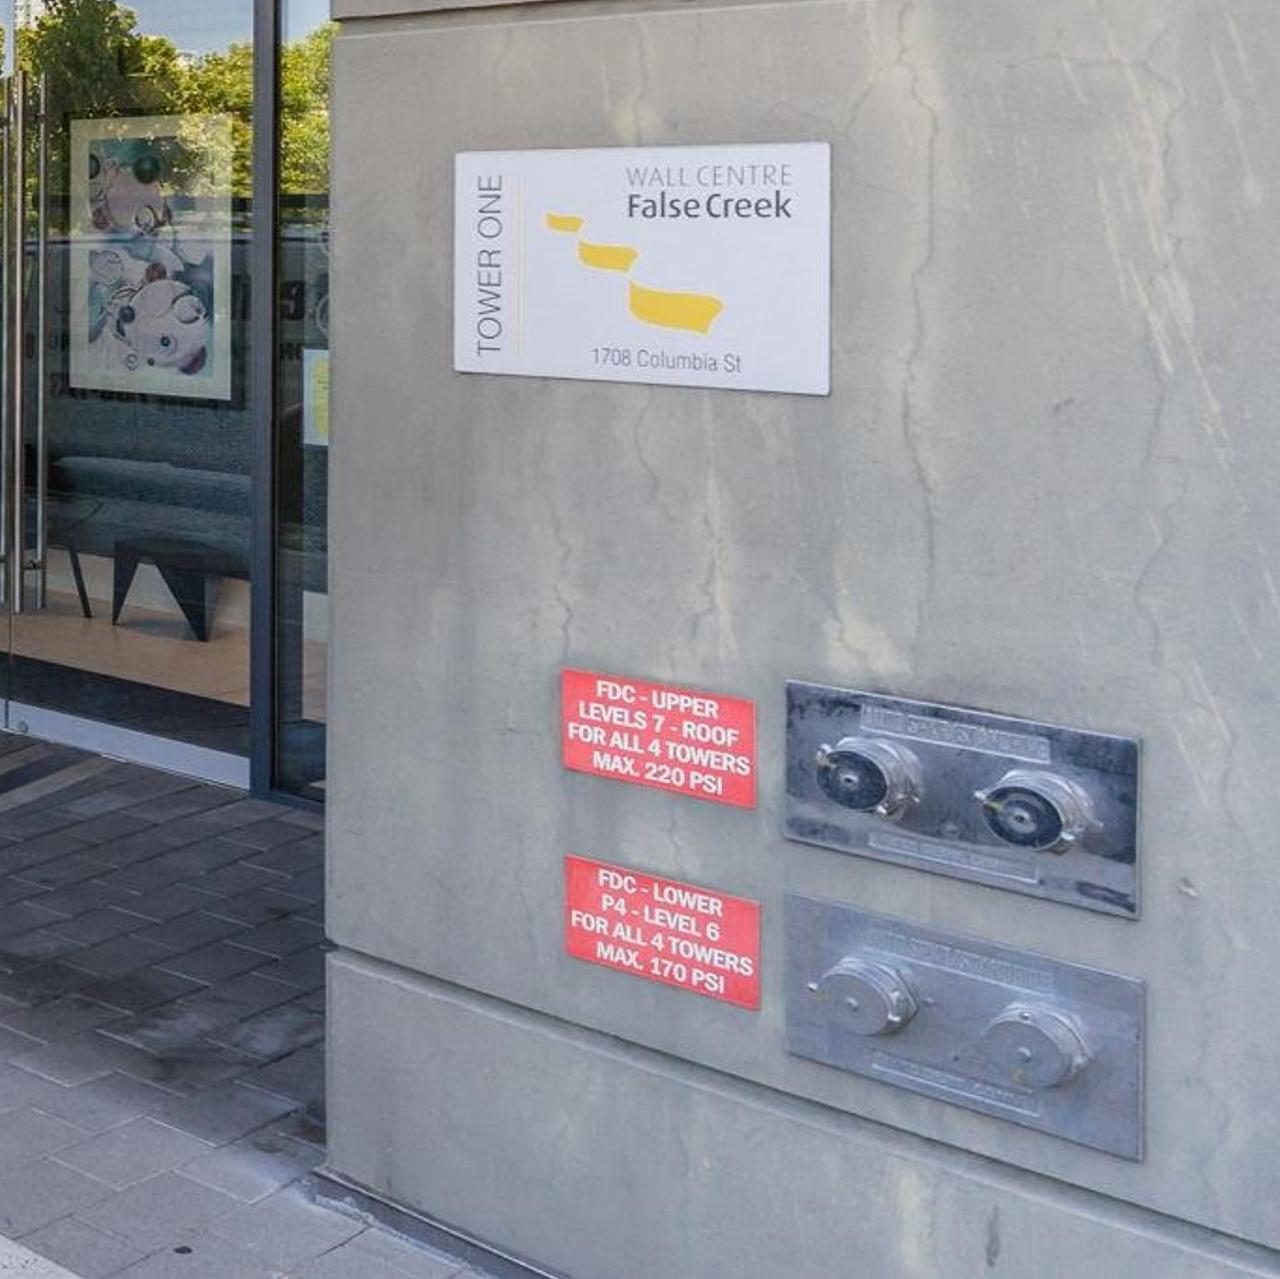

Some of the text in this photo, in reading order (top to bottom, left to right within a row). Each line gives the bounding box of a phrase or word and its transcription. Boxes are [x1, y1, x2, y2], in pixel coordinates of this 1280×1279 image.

[626, 164, 793, 187] WALL CENTRE
[628, 190, 792, 218] False Creek
[477, 174, 503, 357] TOWER ONE
[591, 347, 741, 373] 1708 Columbia St
[597, 680, 636, 703] FDC
[652, 690, 719, 719] UPPER
[578, 701, 647, 730] LEVELS
[653, 714, 665, 733] 7
[682, 721, 739, 747] ROOF
[568, 723, 750, 776] FOR ALL 4 TOWERS
[593, 751, 723, 795] MAX. 220 PSI
[598, 869, 637, 894] FDC
[653, 882, 723, 917] LOWER
[601, 894, 627, 916] P4
[644, 906, 702, 937] LEVEL
[706, 922, 720, 942] 6
[571, 910, 754, 977] FOR ALL 4 TOWERS
[596, 942, 725, 994] MAX. 170 PSI
